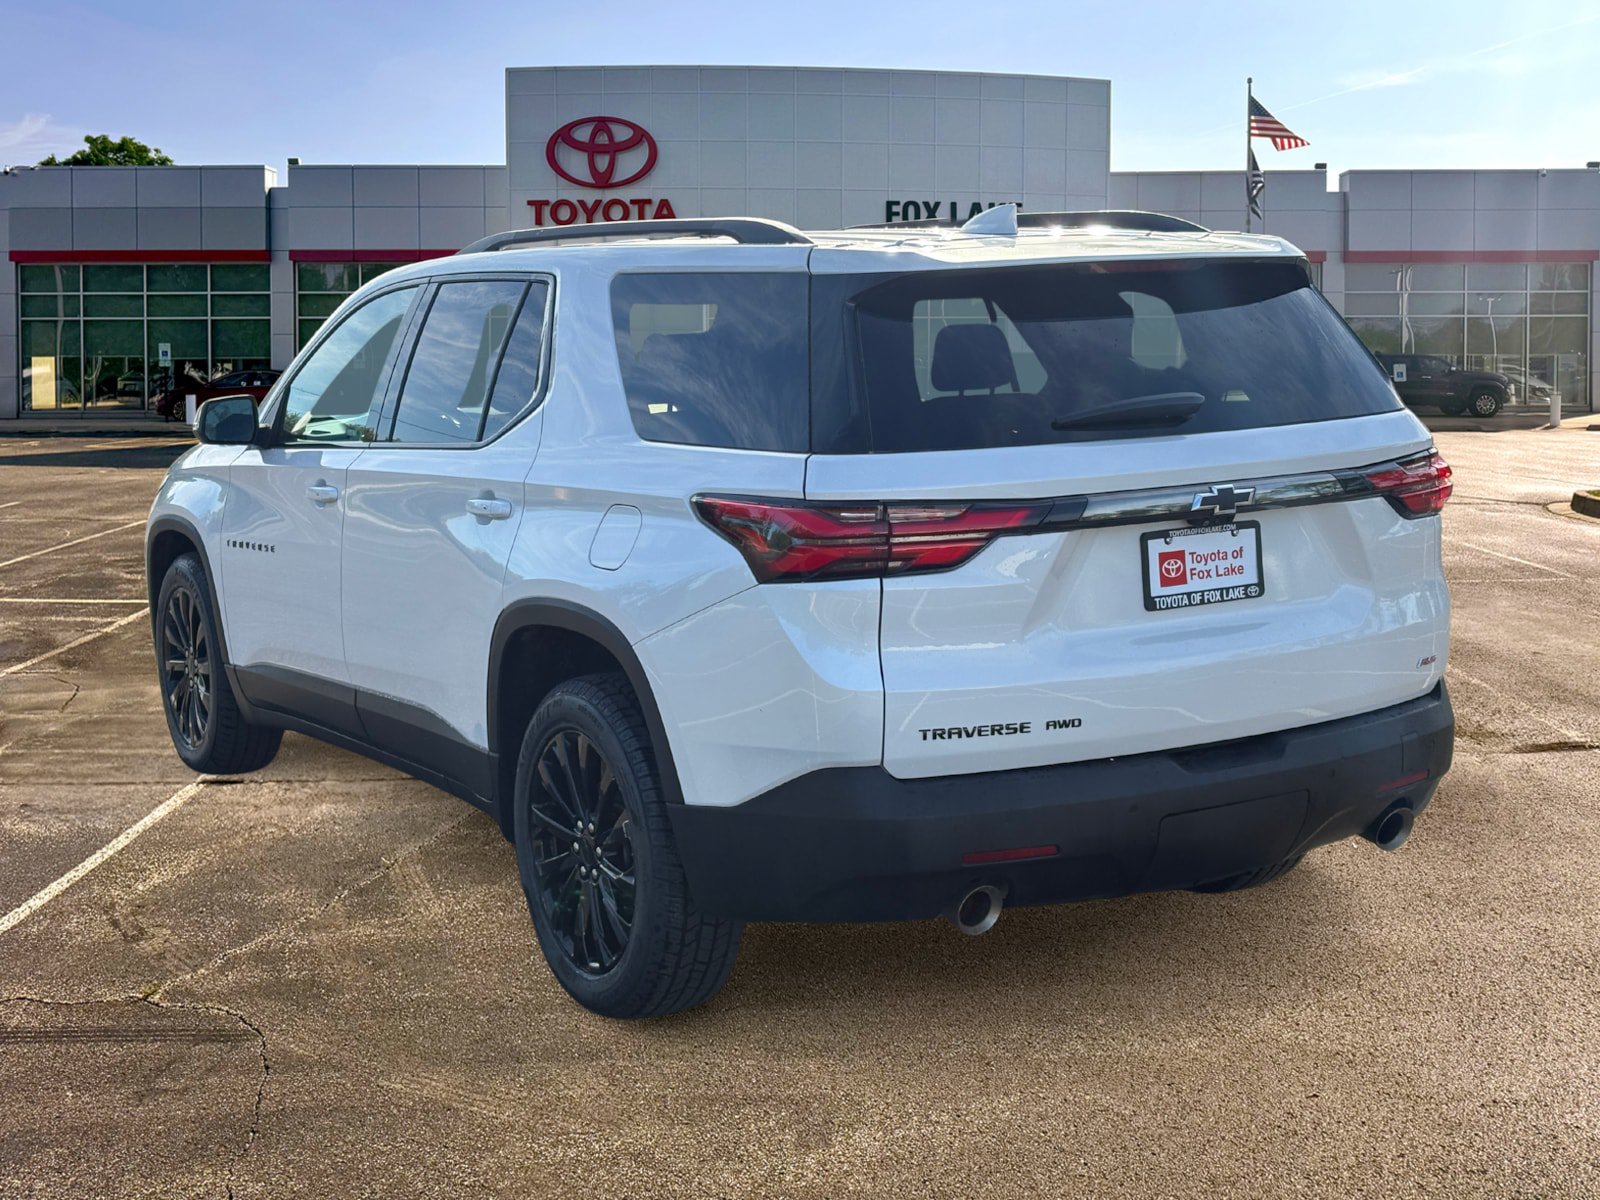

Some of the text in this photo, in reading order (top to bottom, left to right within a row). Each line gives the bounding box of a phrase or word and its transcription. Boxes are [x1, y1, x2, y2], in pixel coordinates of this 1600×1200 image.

[527, 199, 676, 226] TOYOTA
[886, 200, 942, 223] FOX
[1189, 546, 1244, 566] Toyota of
[1190, 563, 1245, 580] Fox Lake
[1154, 586, 1245, 609] TOYOTA OF FOX LAKE
[918, 718, 1082, 741] TRAVERSE AWD
